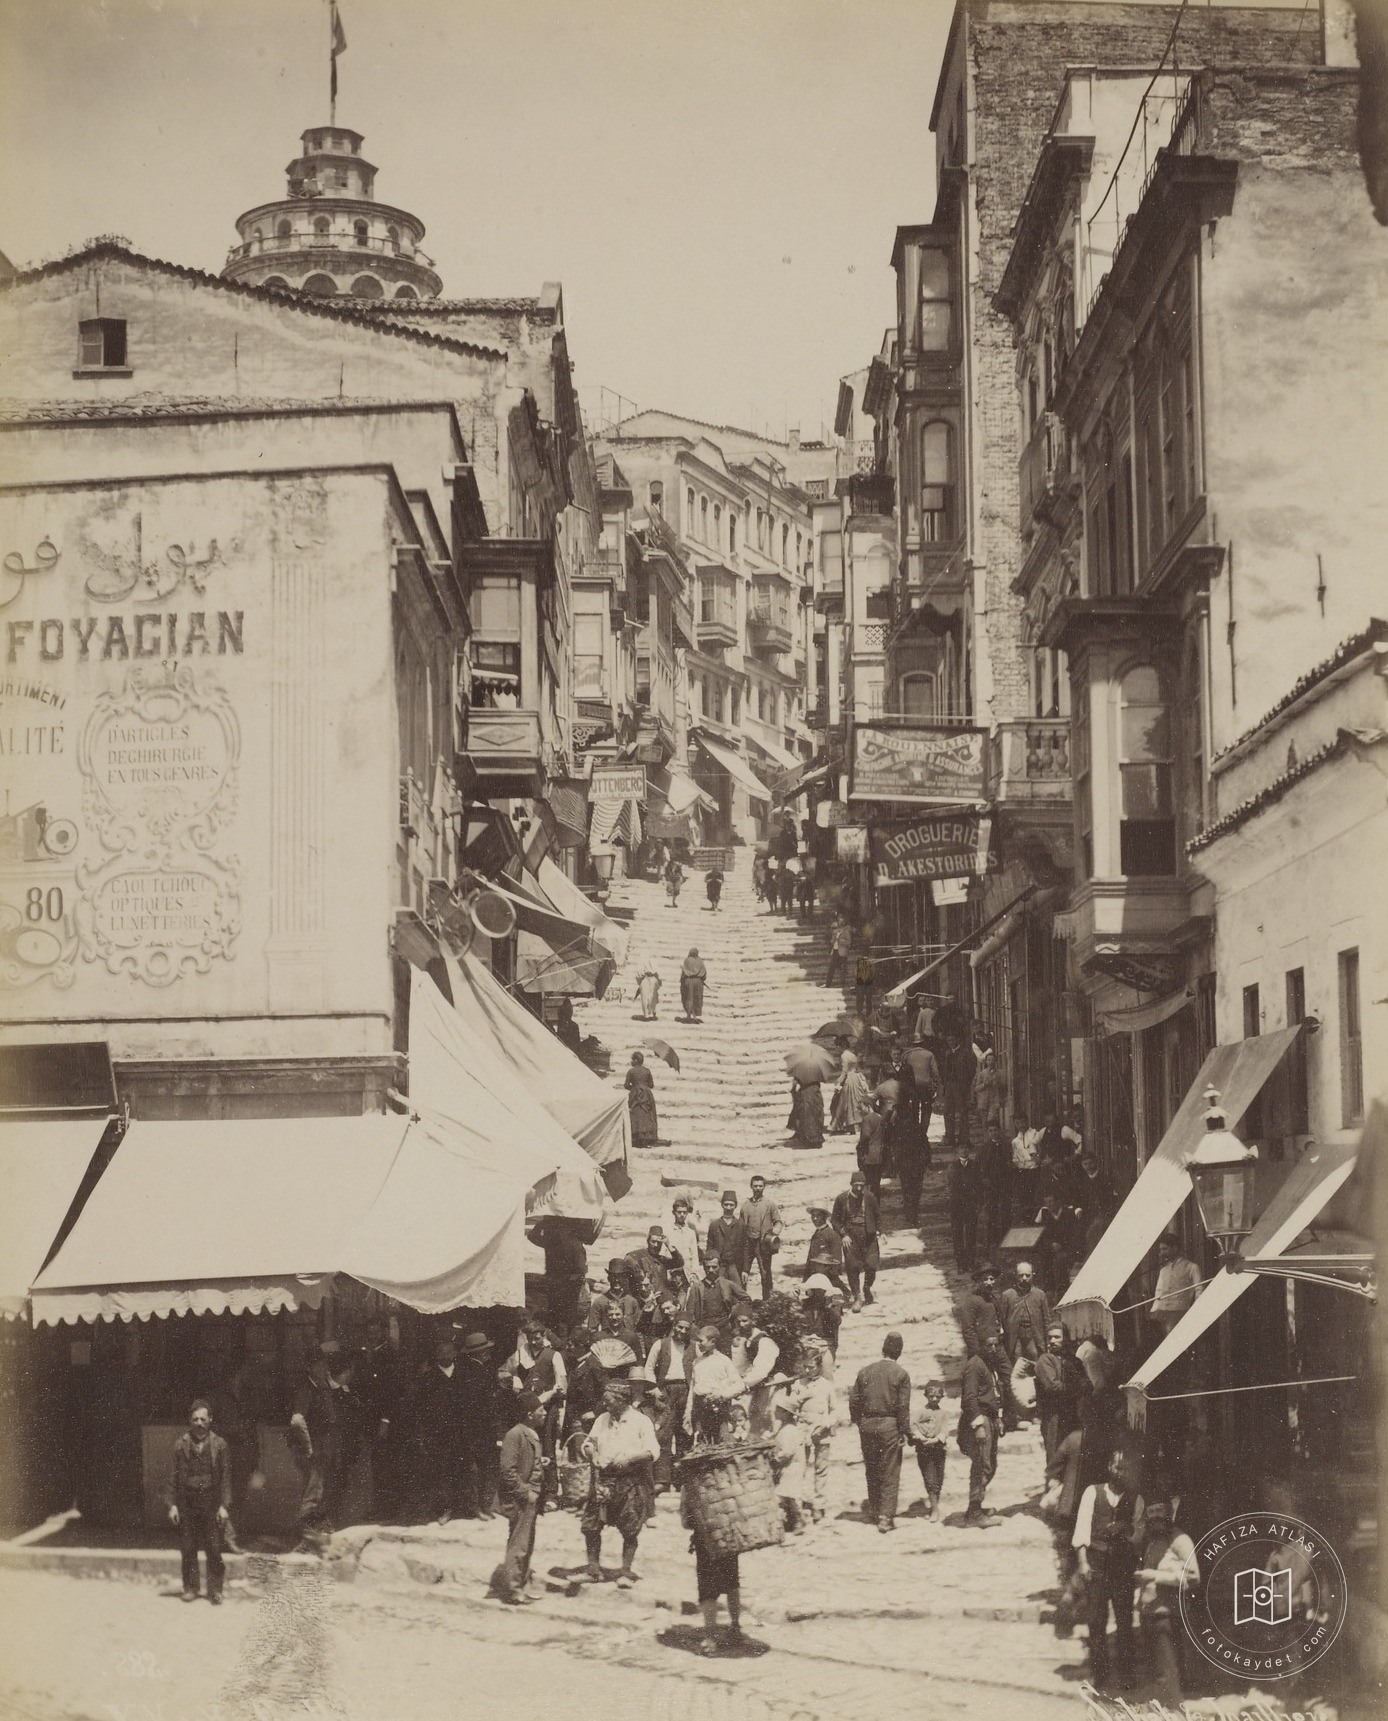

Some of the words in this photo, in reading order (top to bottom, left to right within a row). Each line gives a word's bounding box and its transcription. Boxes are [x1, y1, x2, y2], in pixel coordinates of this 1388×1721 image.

[7, 610, 244, 663] FOYAGIAN
[108, 769, 127, 784] EN
[131, 767, 161, 783] TOUS
[164, 765, 220, 781] GENRES
[884, 822, 980, 858] DROGUERIE
[26, 887, 64, 921] 80
[111, 896, 184, 915] OPTIQUES
[111, 915, 212, 931] LUNETTERIES
